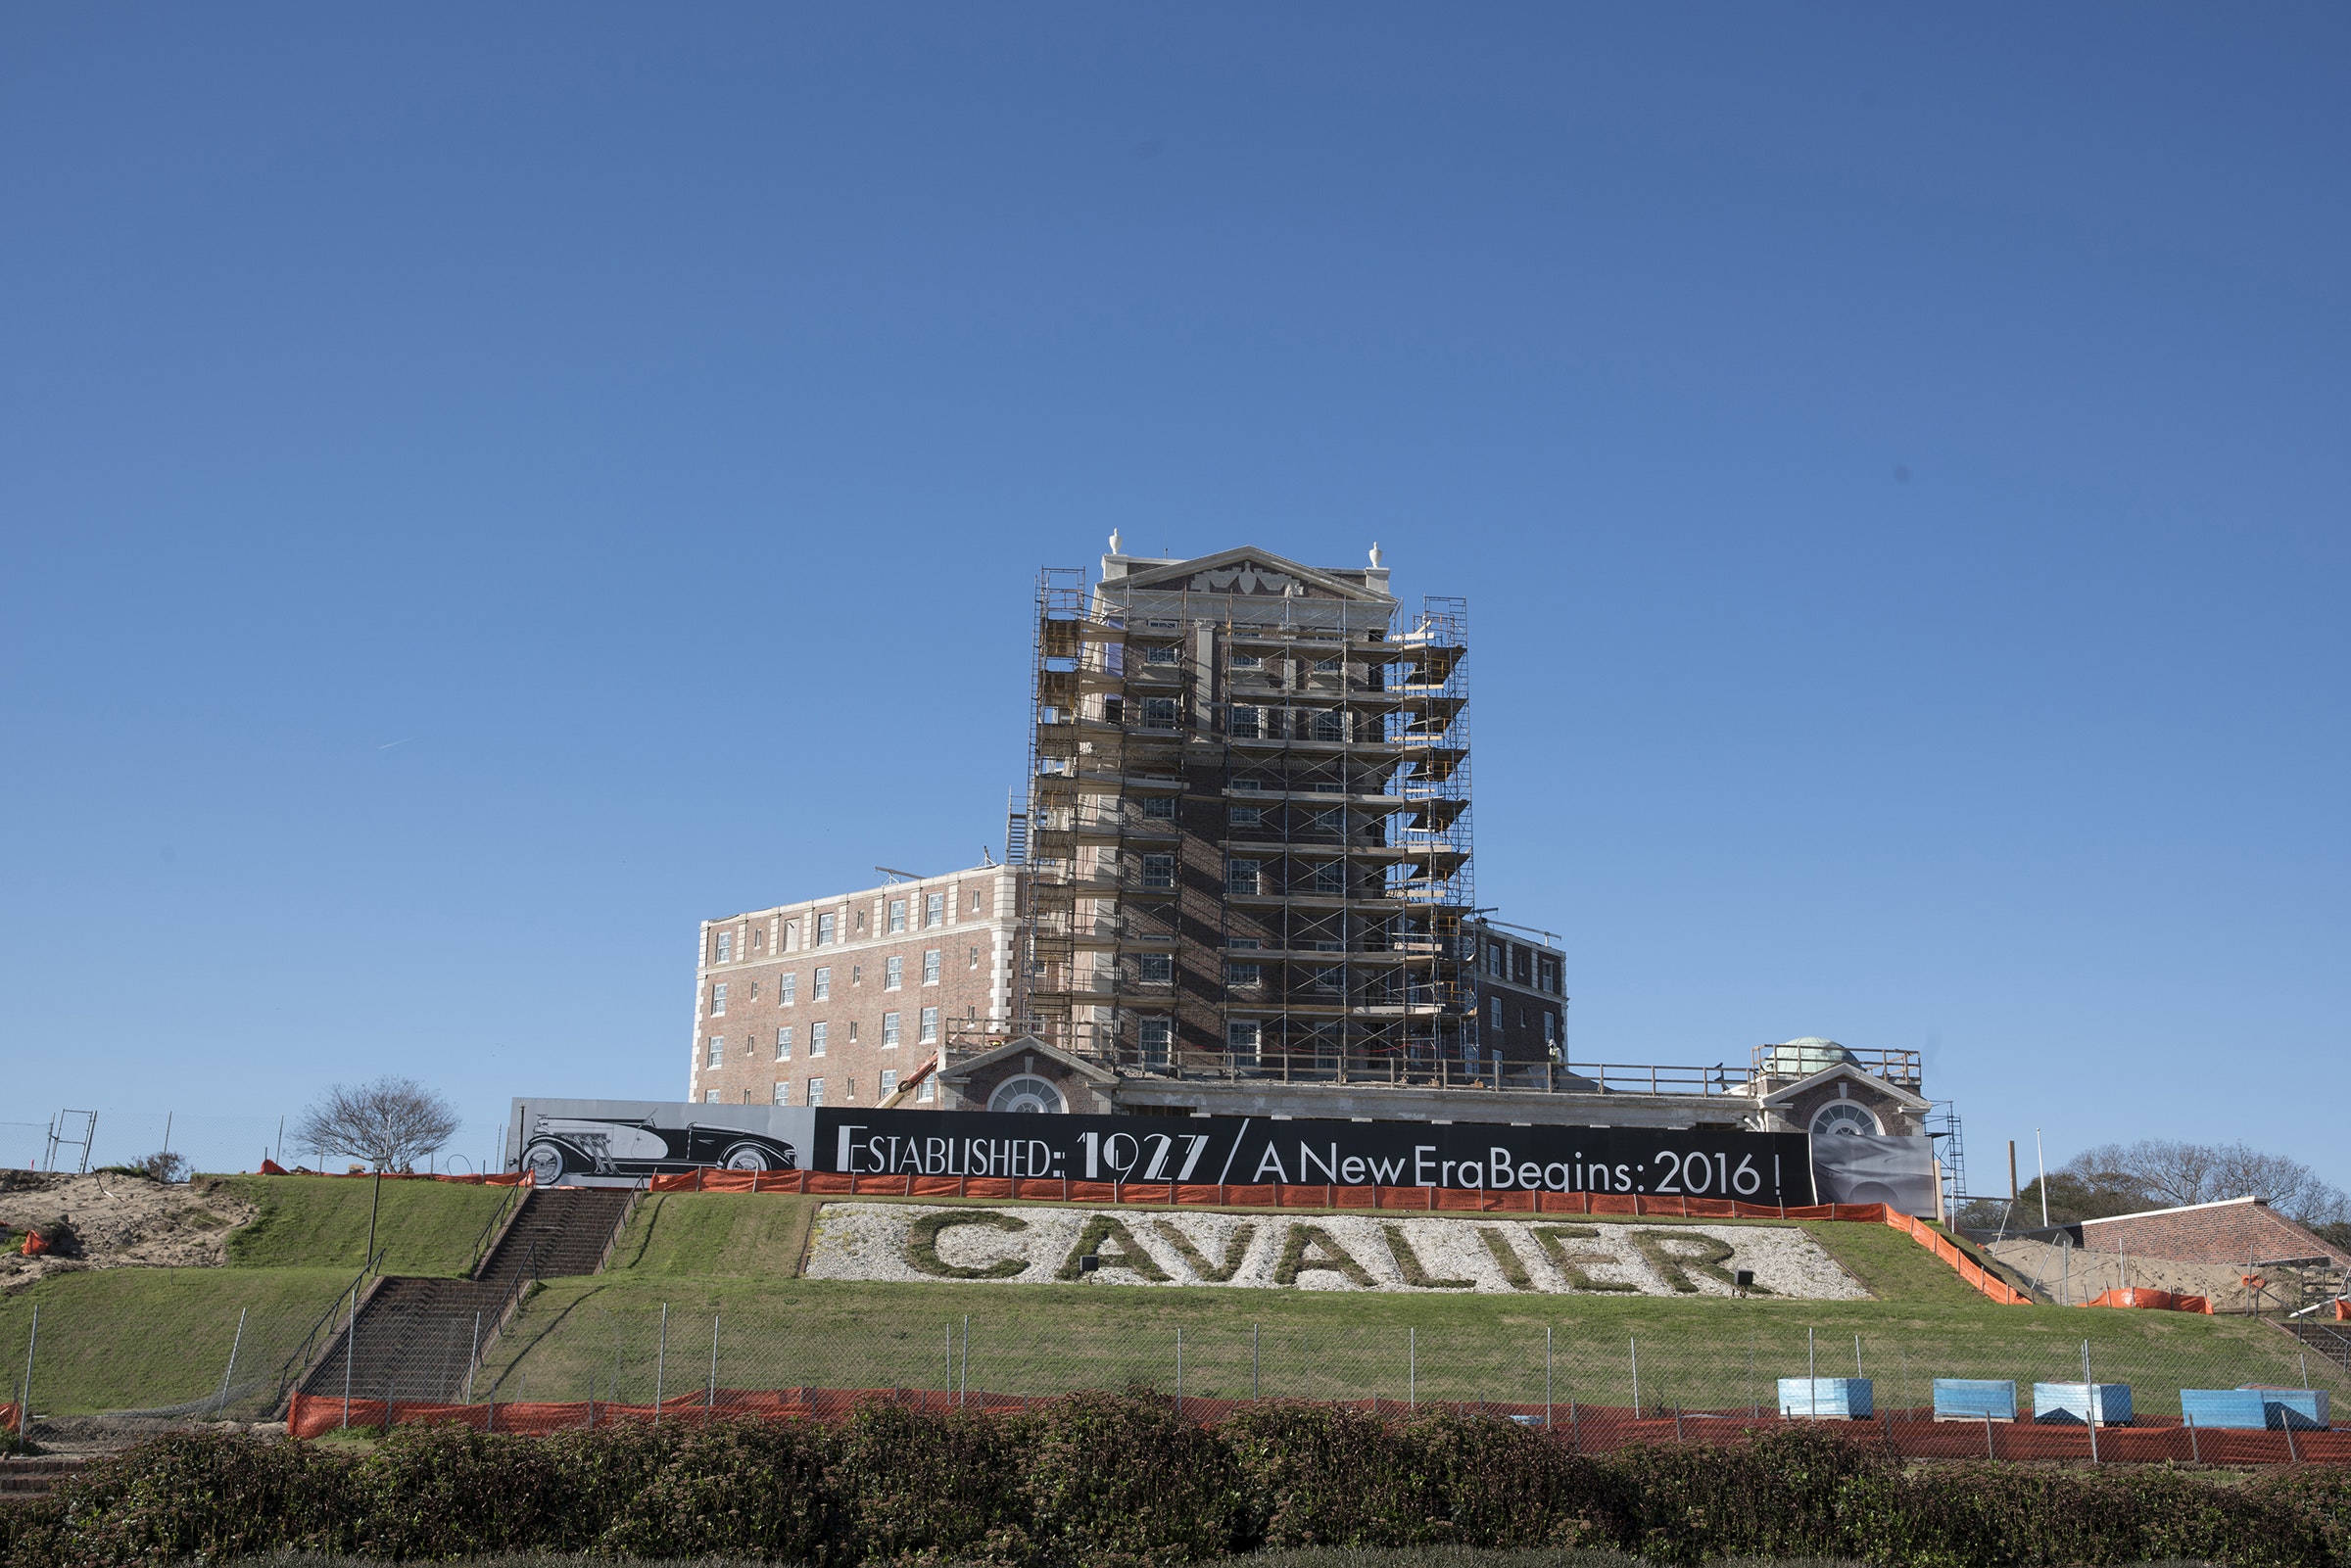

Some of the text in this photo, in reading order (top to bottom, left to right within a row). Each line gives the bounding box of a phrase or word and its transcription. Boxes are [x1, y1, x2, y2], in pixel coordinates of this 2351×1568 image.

[1076, 1131, 1210, 1185] 1927
[1252, 1139, 1289, 1183] A
[1300, 1139, 1407, 1185] New
[905, 1210, 1771, 1295] CAVALIER
